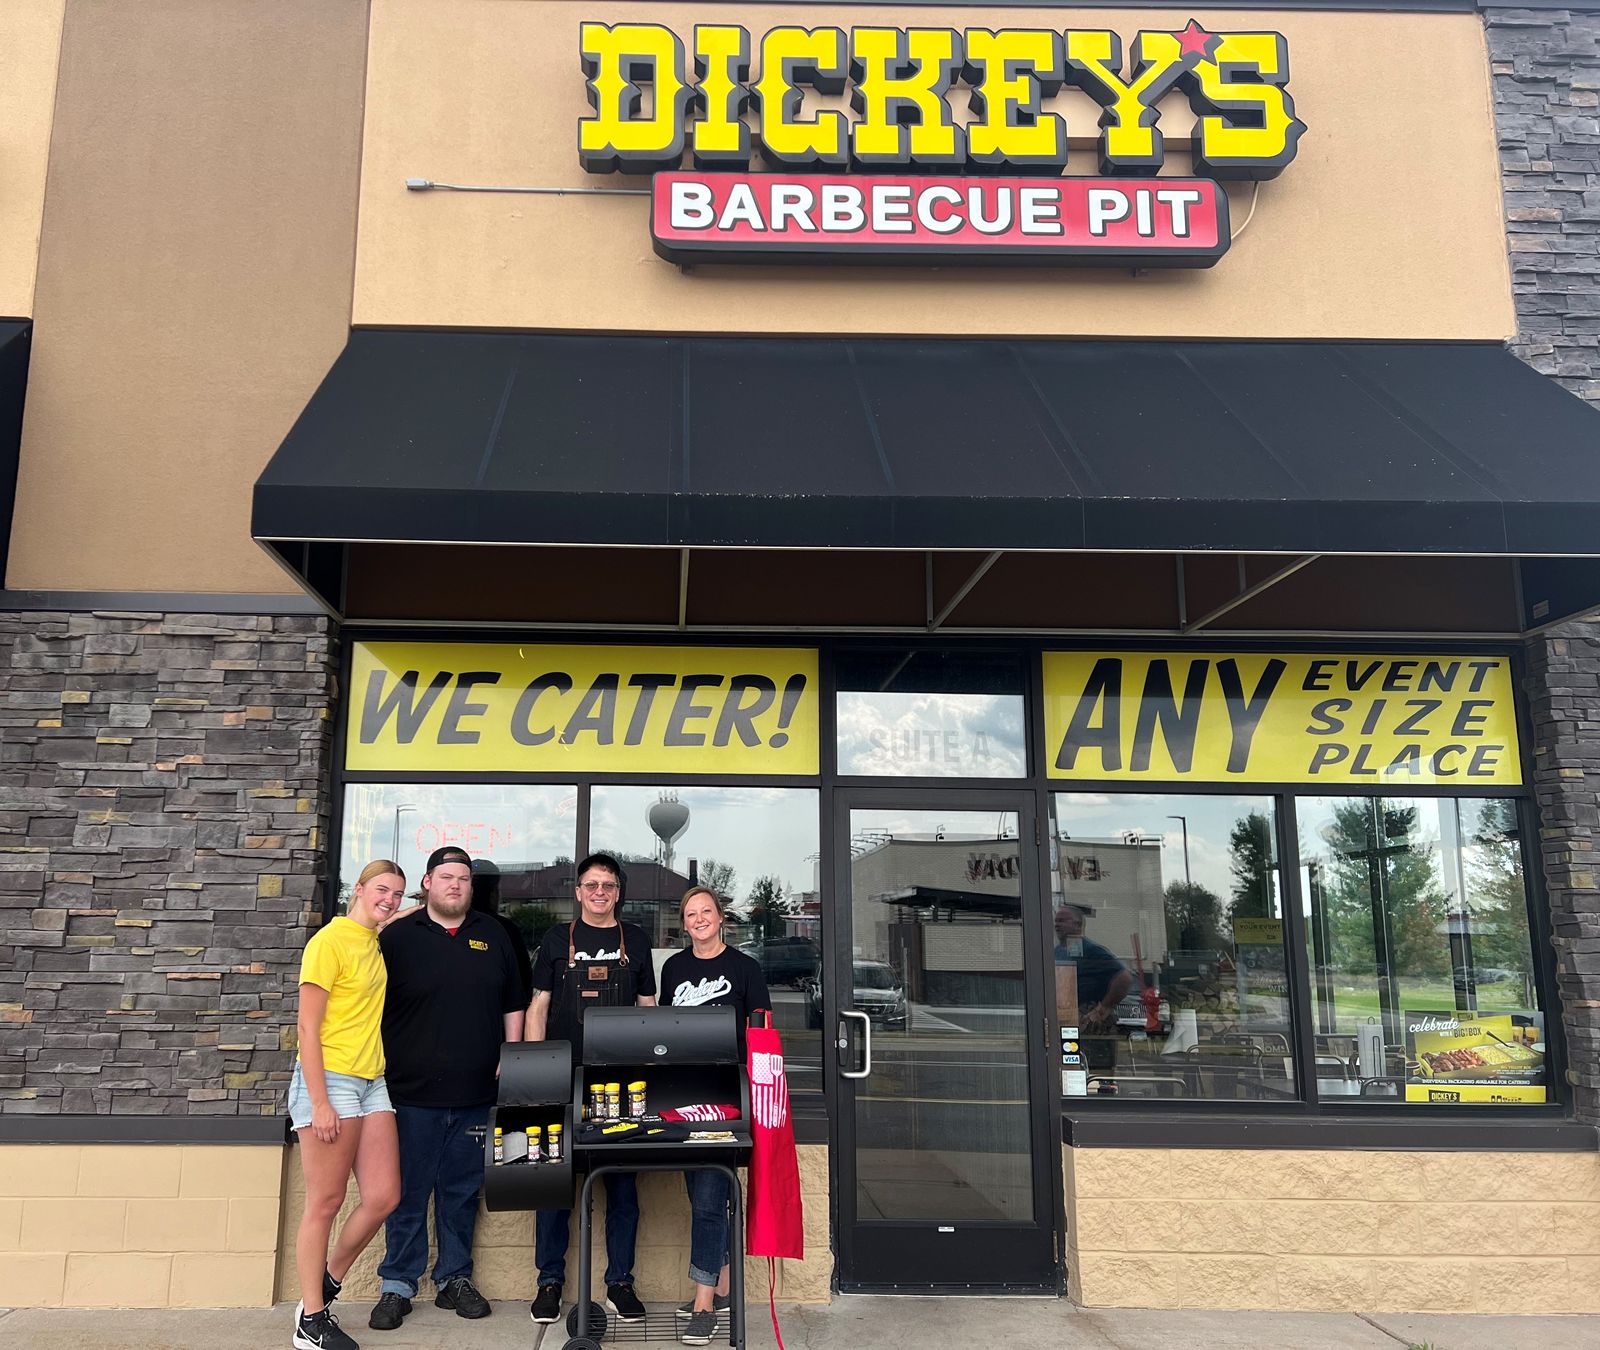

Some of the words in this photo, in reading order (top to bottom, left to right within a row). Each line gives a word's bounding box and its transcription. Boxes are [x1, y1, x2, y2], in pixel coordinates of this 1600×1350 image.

[670, 182, 1062, 235] BARBECUE
[1088, 190, 1199, 236] PIT
[1302, 659, 1501, 693] EVENT
[359, 669, 501, 745] WE
[511, 671, 807, 749] CATER!
[1055, 657, 1288, 774] ANY
[1306, 698, 1495, 737] SIZE
[869, 728, 960, 763] SUITE
[972, 731, 992, 762] A
[1308, 743, 1505, 777] PLACE
[415, 823, 513, 854] OPEN
[1409, 1016, 1459, 1033] celebrate
[1454, 1029, 1466, 1038] BIG
[1468, 1027, 1482, 1037] BOX
